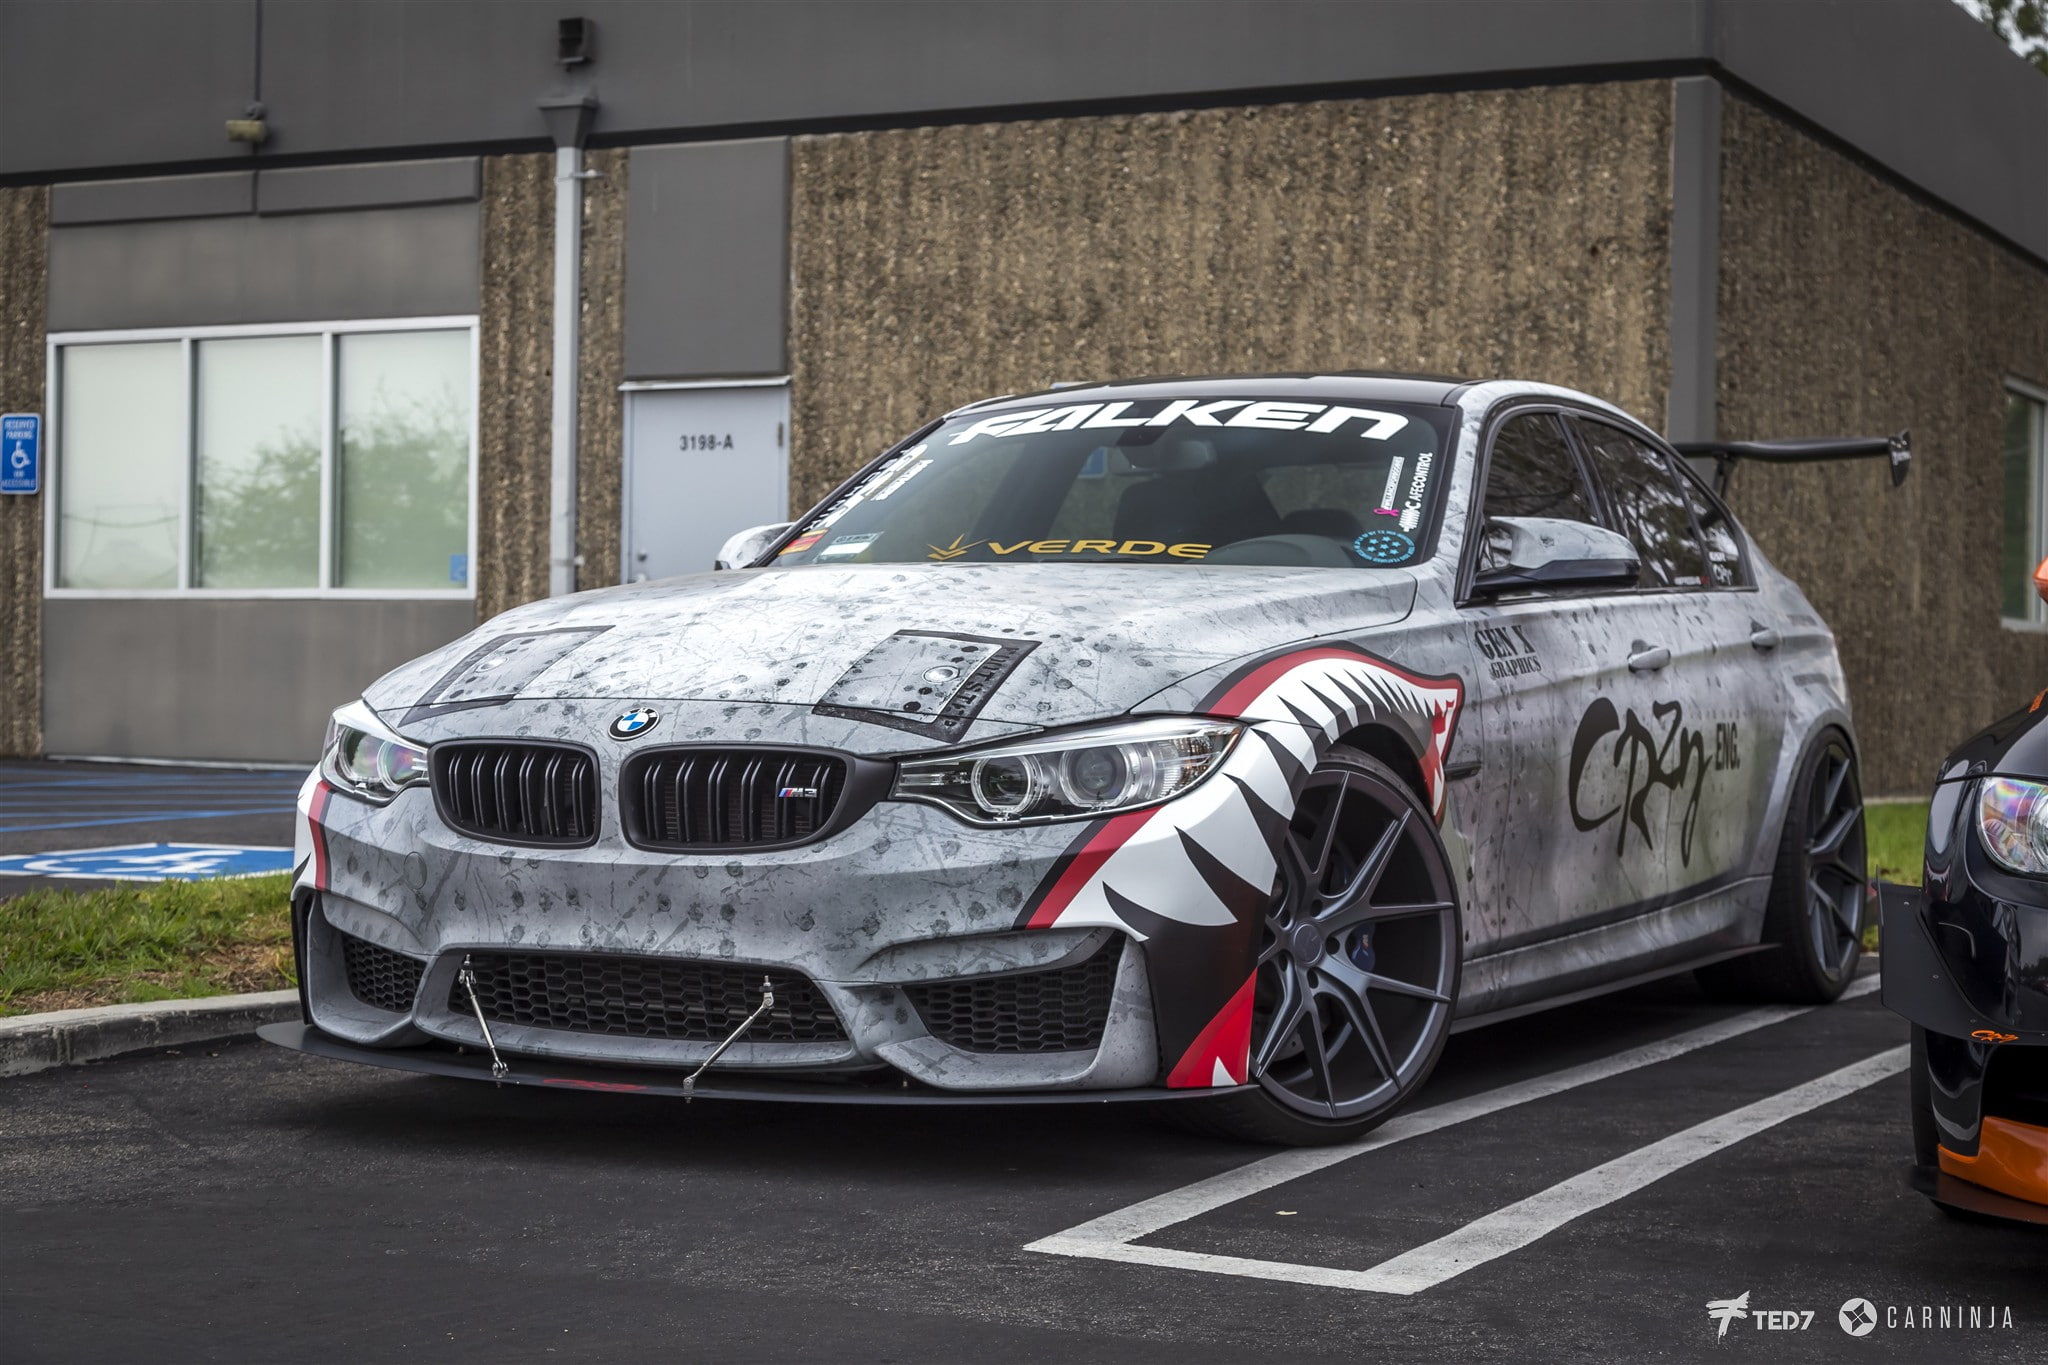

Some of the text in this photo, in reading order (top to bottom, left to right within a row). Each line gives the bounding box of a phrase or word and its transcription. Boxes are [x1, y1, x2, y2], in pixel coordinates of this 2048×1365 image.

[948, 399, 1409, 446] FALKEN
[680, 434, 734, 451] 3198-A
[988, 539, 1212, 560] VERDE
[1474, 624, 1536, 660] GEN X
[1490, 656, 1542, 679] GRAPHICS
[1715, 722, 1741, 772] ENG.
[785, 787, 818, 798] M3
